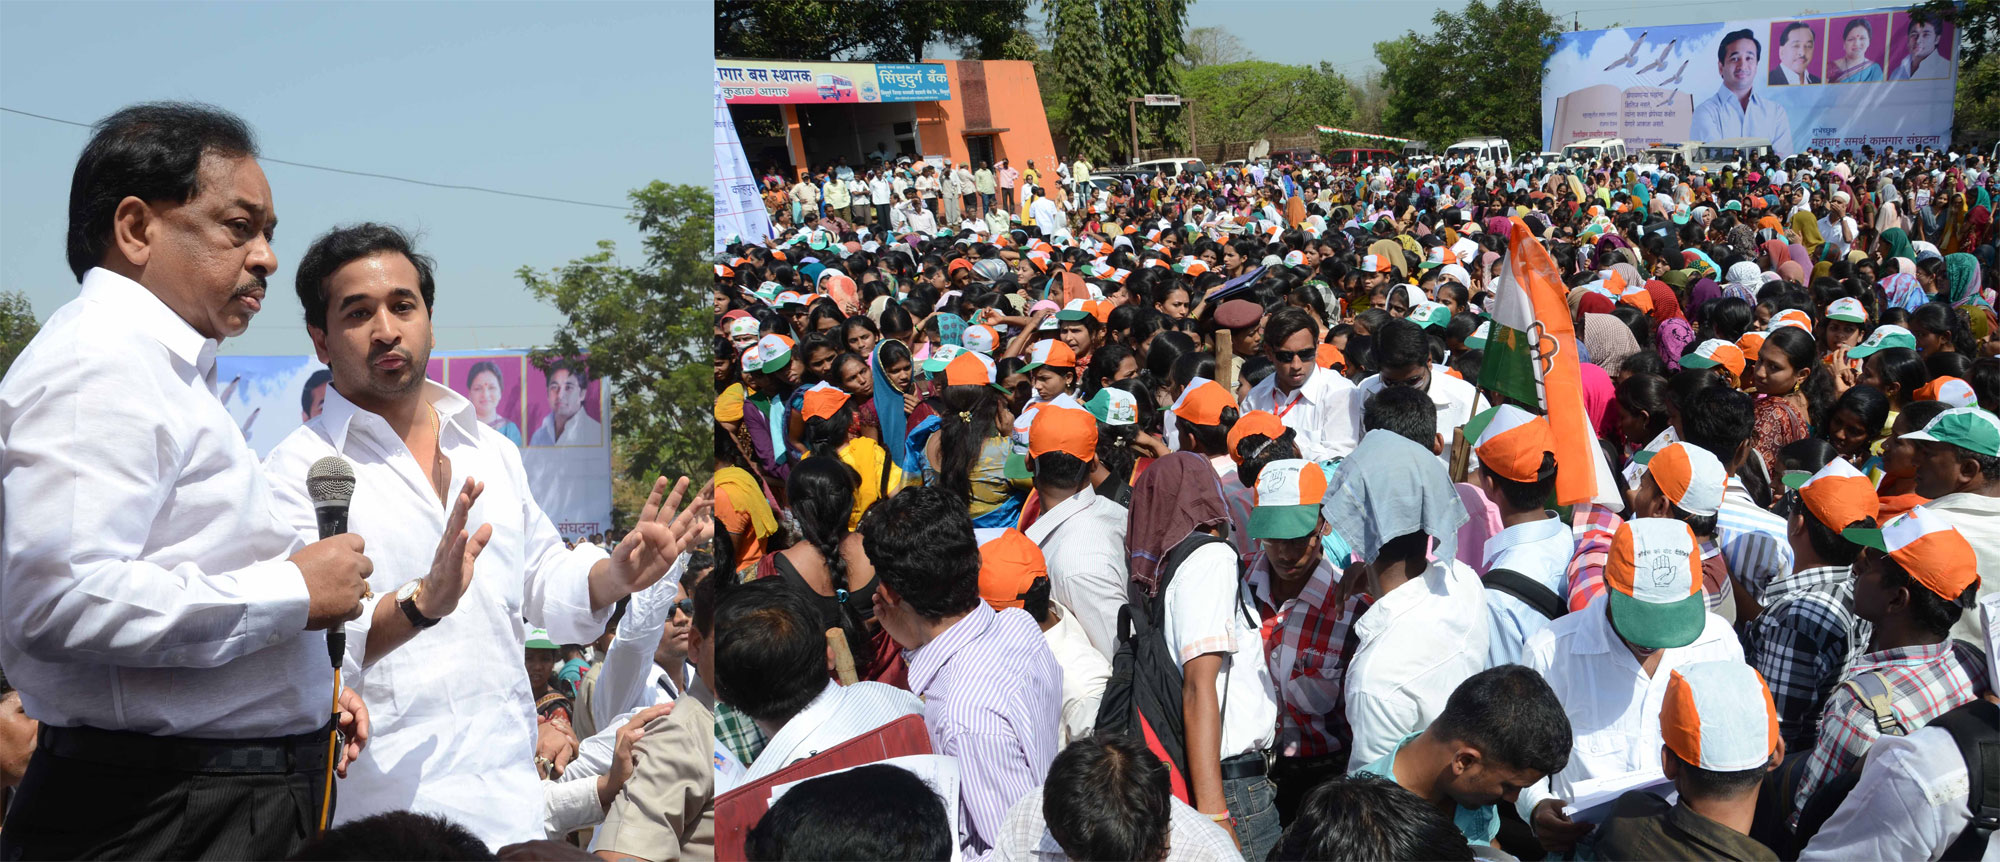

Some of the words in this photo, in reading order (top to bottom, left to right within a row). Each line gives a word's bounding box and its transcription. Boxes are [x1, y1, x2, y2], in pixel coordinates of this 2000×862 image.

[747, 69, 769, 82] बस
[771, 70, 812, 82] स्थानक
[879, 70, 923, 88] सिंधुदुर्ग
[926, 69, 947, 83] बँक
[722, 87, 755, 99] कुडाळ
[759, 87, 789, 97] आगार
[1811, 138, 1841, 148] महाराष्ट्र
[1844, 135, 1867, 146] समर्थ
[1869, 136, 1903, 145] कामगार
[1906, 133, 1941, 144] संघटना
[558, 518, 599, 535] संघटना
